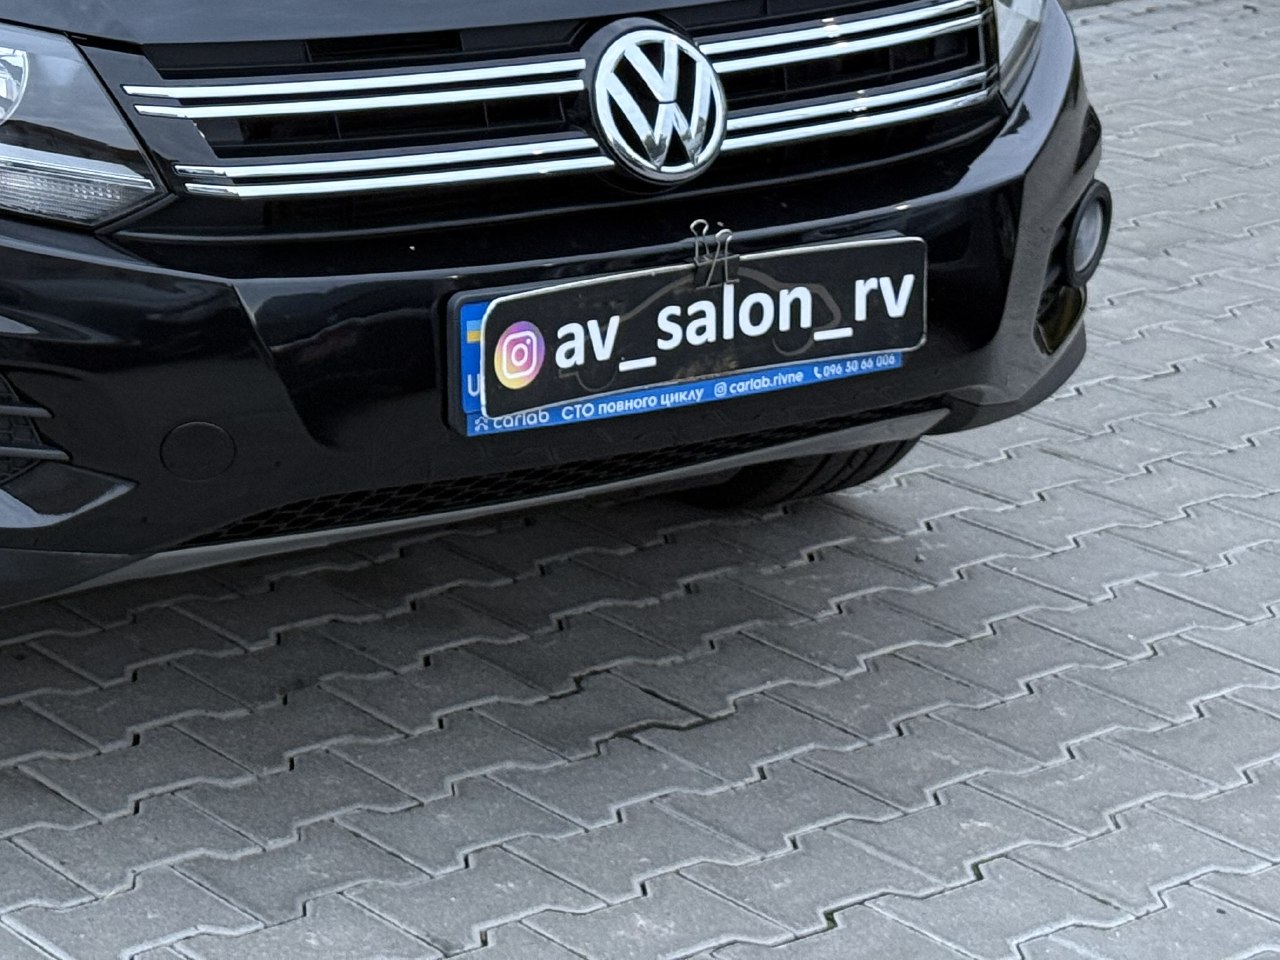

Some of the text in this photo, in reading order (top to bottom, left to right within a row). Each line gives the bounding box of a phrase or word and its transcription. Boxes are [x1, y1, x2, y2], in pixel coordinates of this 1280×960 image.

[554, 272, 916, 372] av_salon_rv
[492, 408, 550, 430] carlab
[561, 402, 595, 421] СТО
[598, 395, 658, 415] повного
[660, 388, 705, 408] циклу
